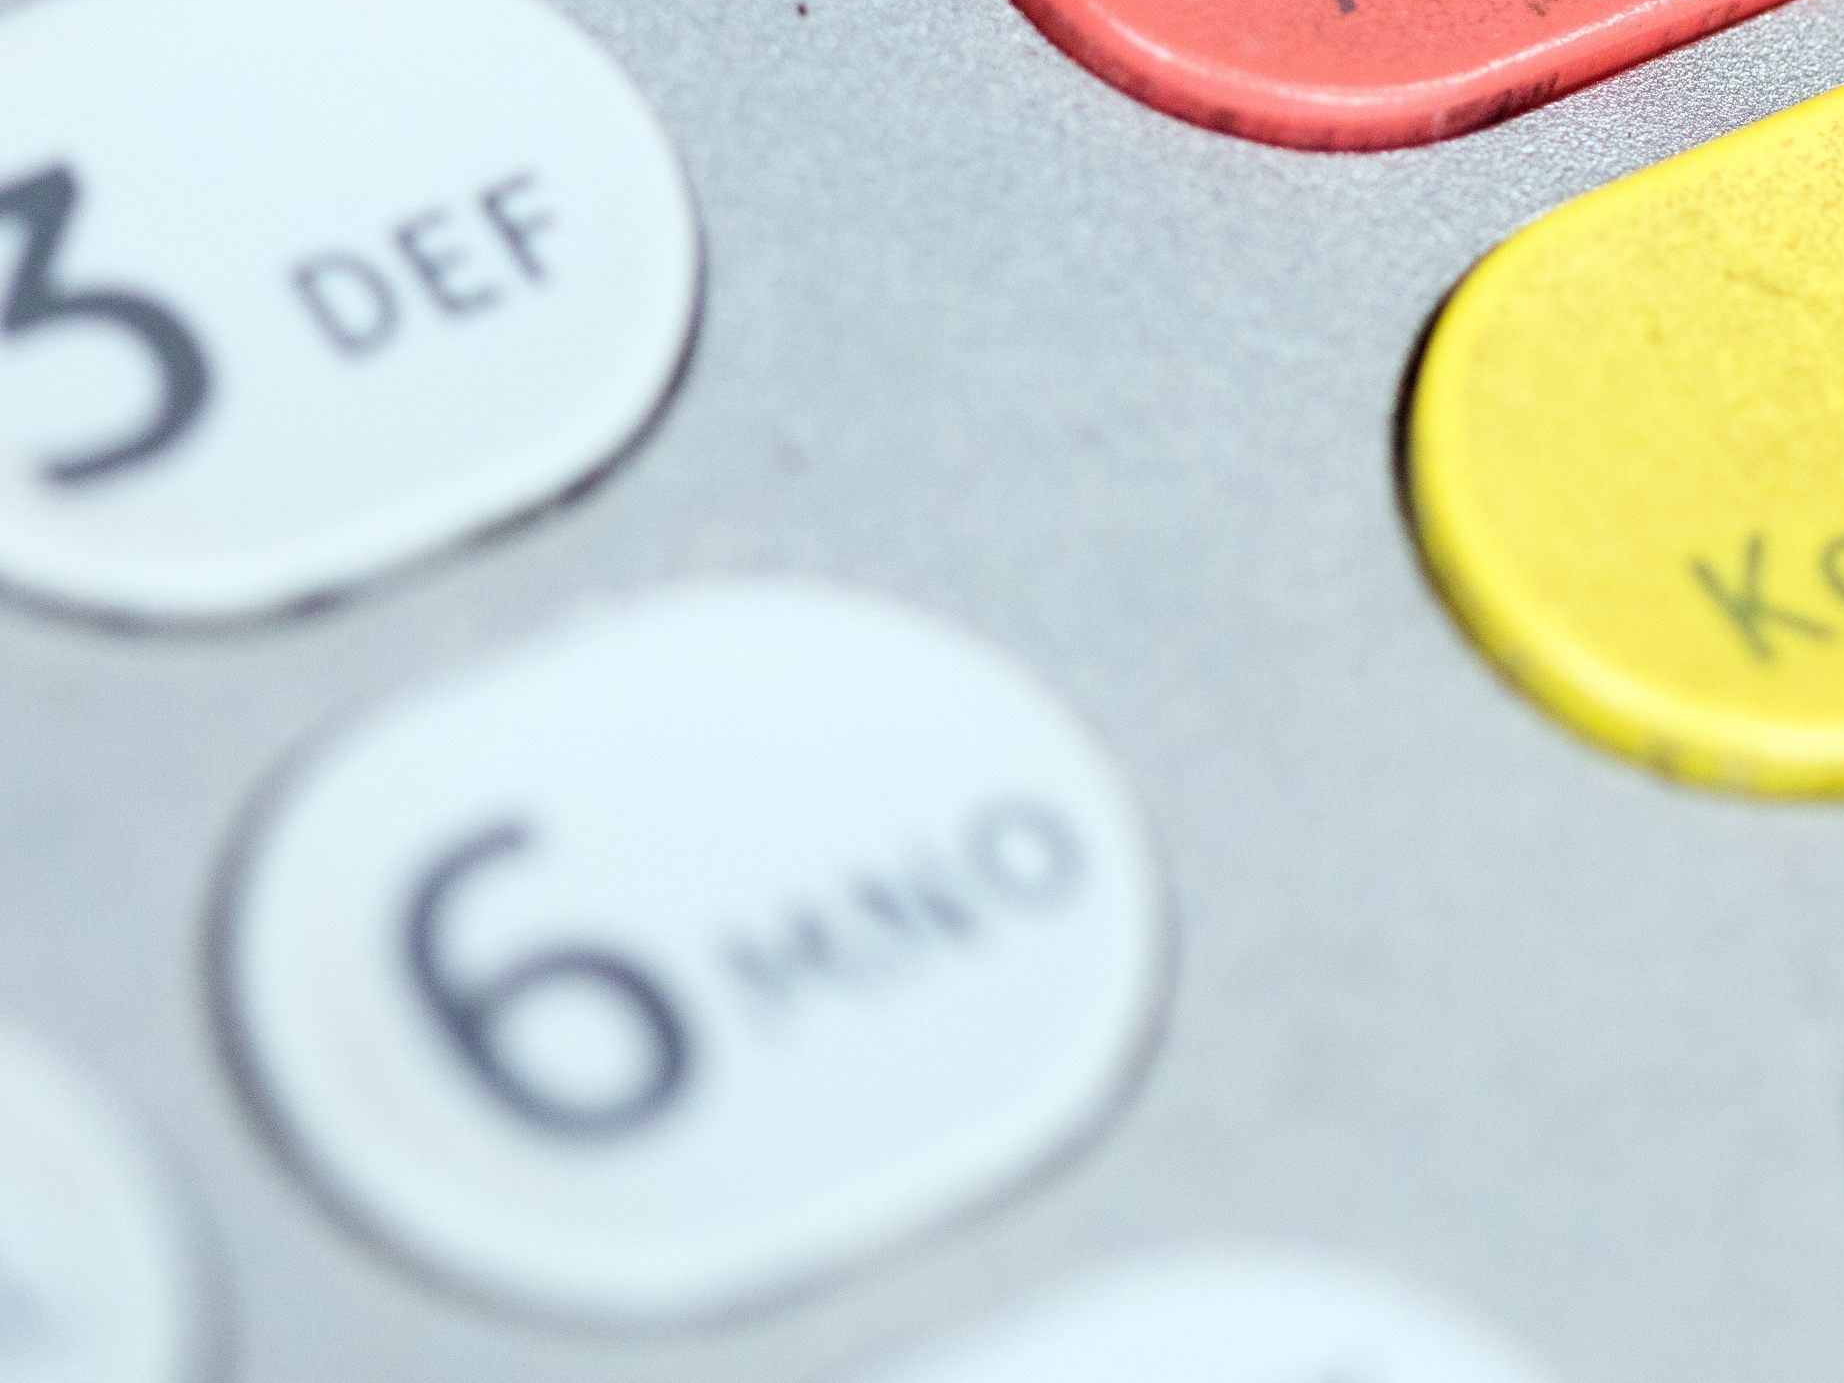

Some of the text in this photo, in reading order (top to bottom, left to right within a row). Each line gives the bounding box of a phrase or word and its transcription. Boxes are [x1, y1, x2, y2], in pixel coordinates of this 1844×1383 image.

[0, 164, 558, 493] 3 DEF
[397, 814, 698, 1140] 6
